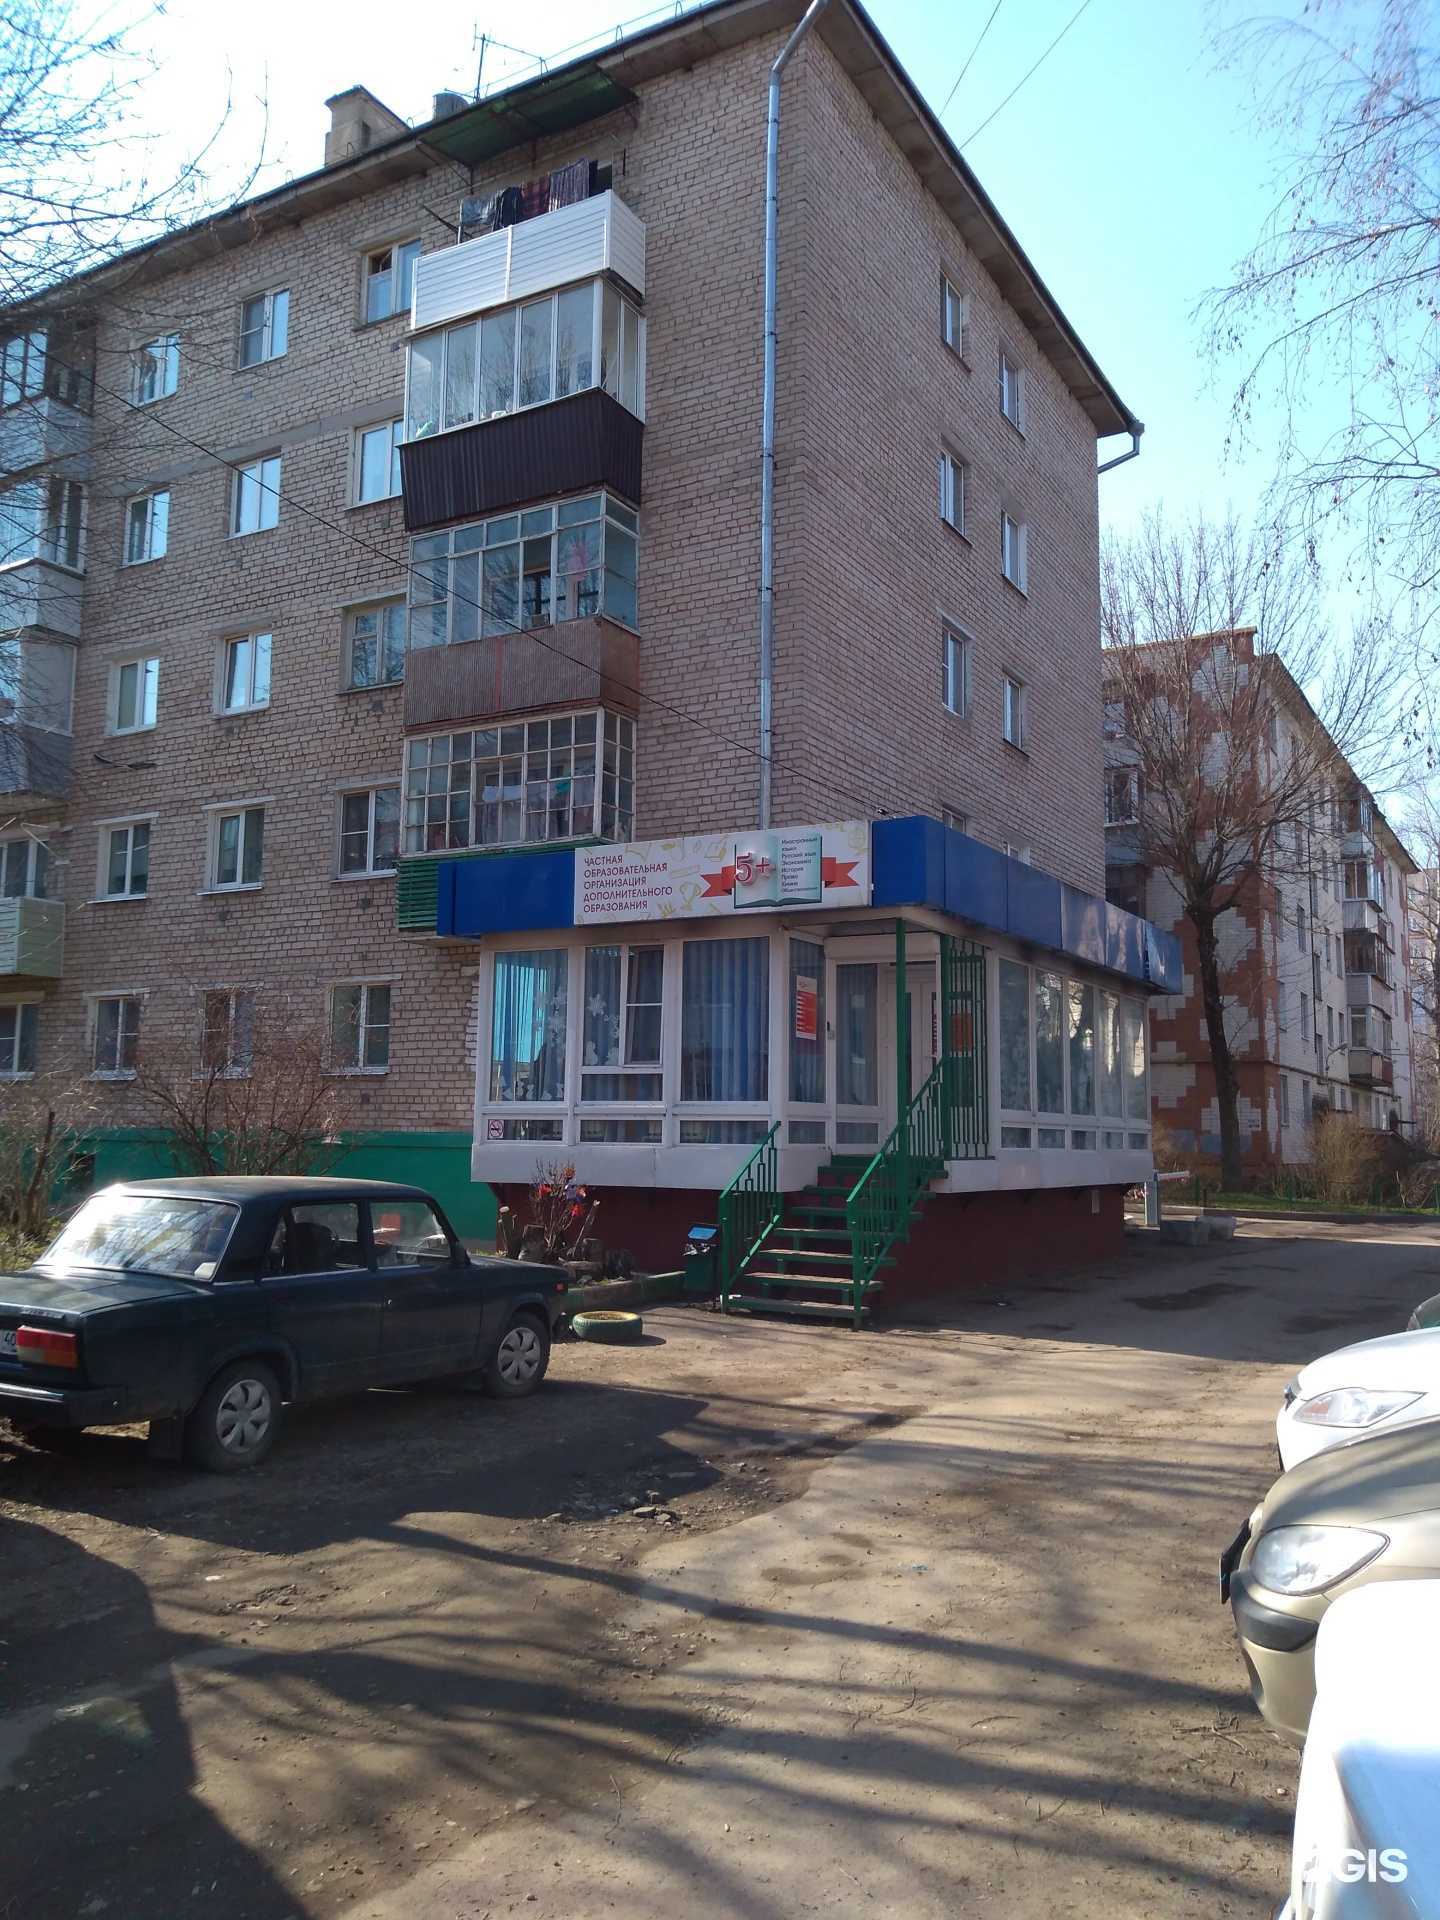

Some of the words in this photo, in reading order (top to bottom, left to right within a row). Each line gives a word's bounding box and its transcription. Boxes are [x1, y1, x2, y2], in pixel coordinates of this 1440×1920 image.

[584, 855, 623, 866] ЧАСТНАЯ
[735, 852, 772, 883] 5+
[584, 863, 668, 878] ОБРАЗОВАТЕЛЬНАЯ
[584, 876, 647, 890] ОРГАНИЗАЦИЯ
[583, 886, 673, 903] ДОПОЛНИТЕЛЬНОГО
[583, 901, 648, 913] ОБРАЗОВАНИЯ
